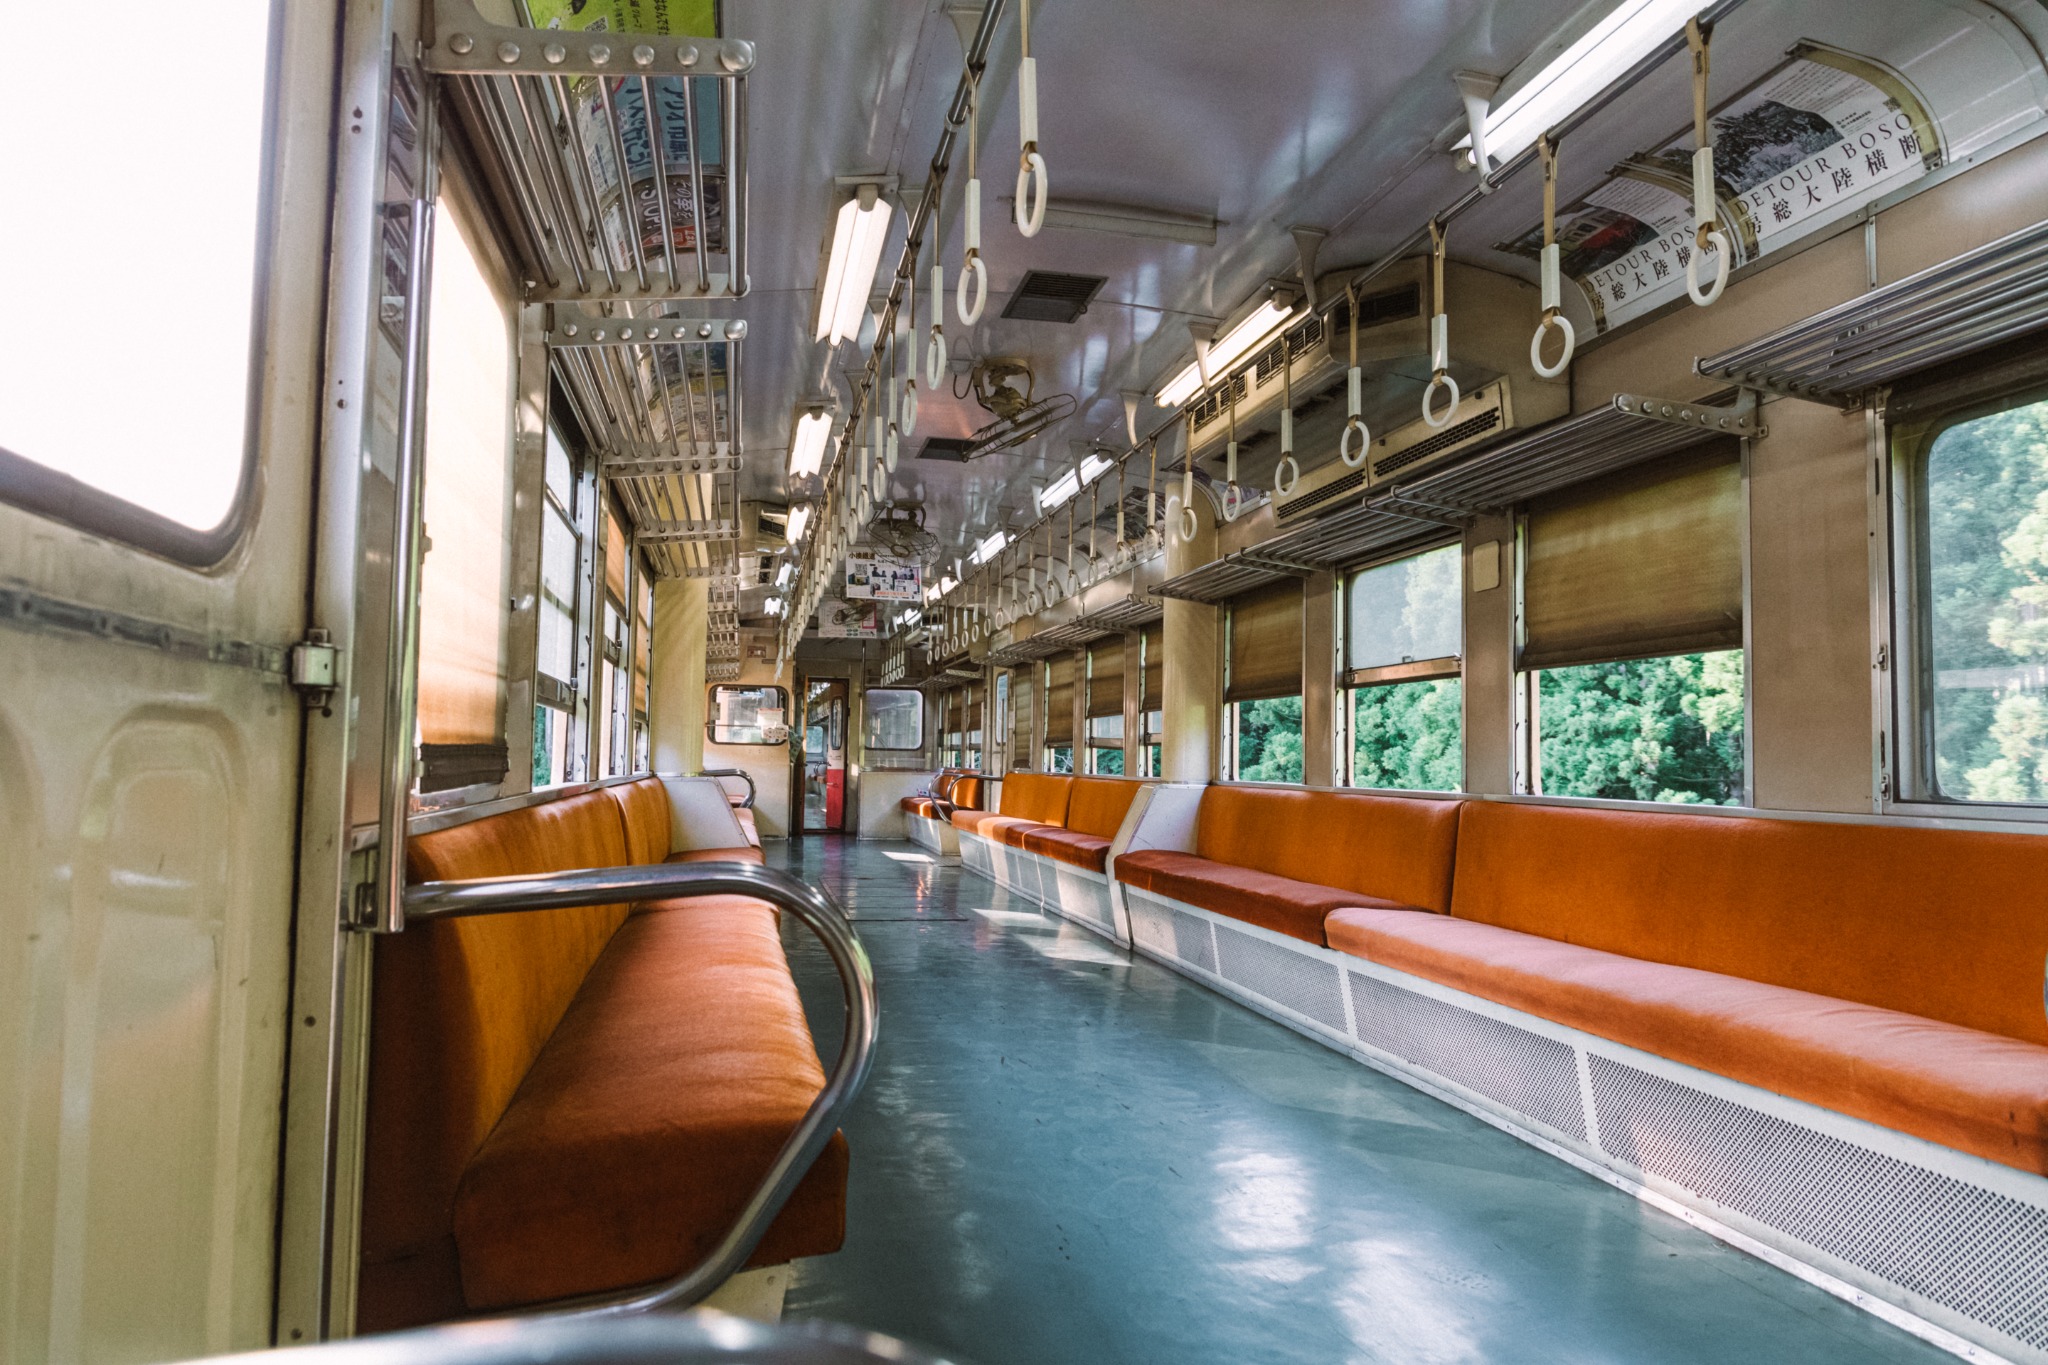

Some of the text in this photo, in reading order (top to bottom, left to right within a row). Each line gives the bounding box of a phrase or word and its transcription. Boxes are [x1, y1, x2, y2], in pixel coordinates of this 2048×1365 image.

[1735, 157, 1832, 216] DETOUR
[1840, 113, 1912, 160] BOSO
[1745, 130, 1922, 234] 房総大陸横断
[1584, 225, 1696, 293] DETOUR BOS
